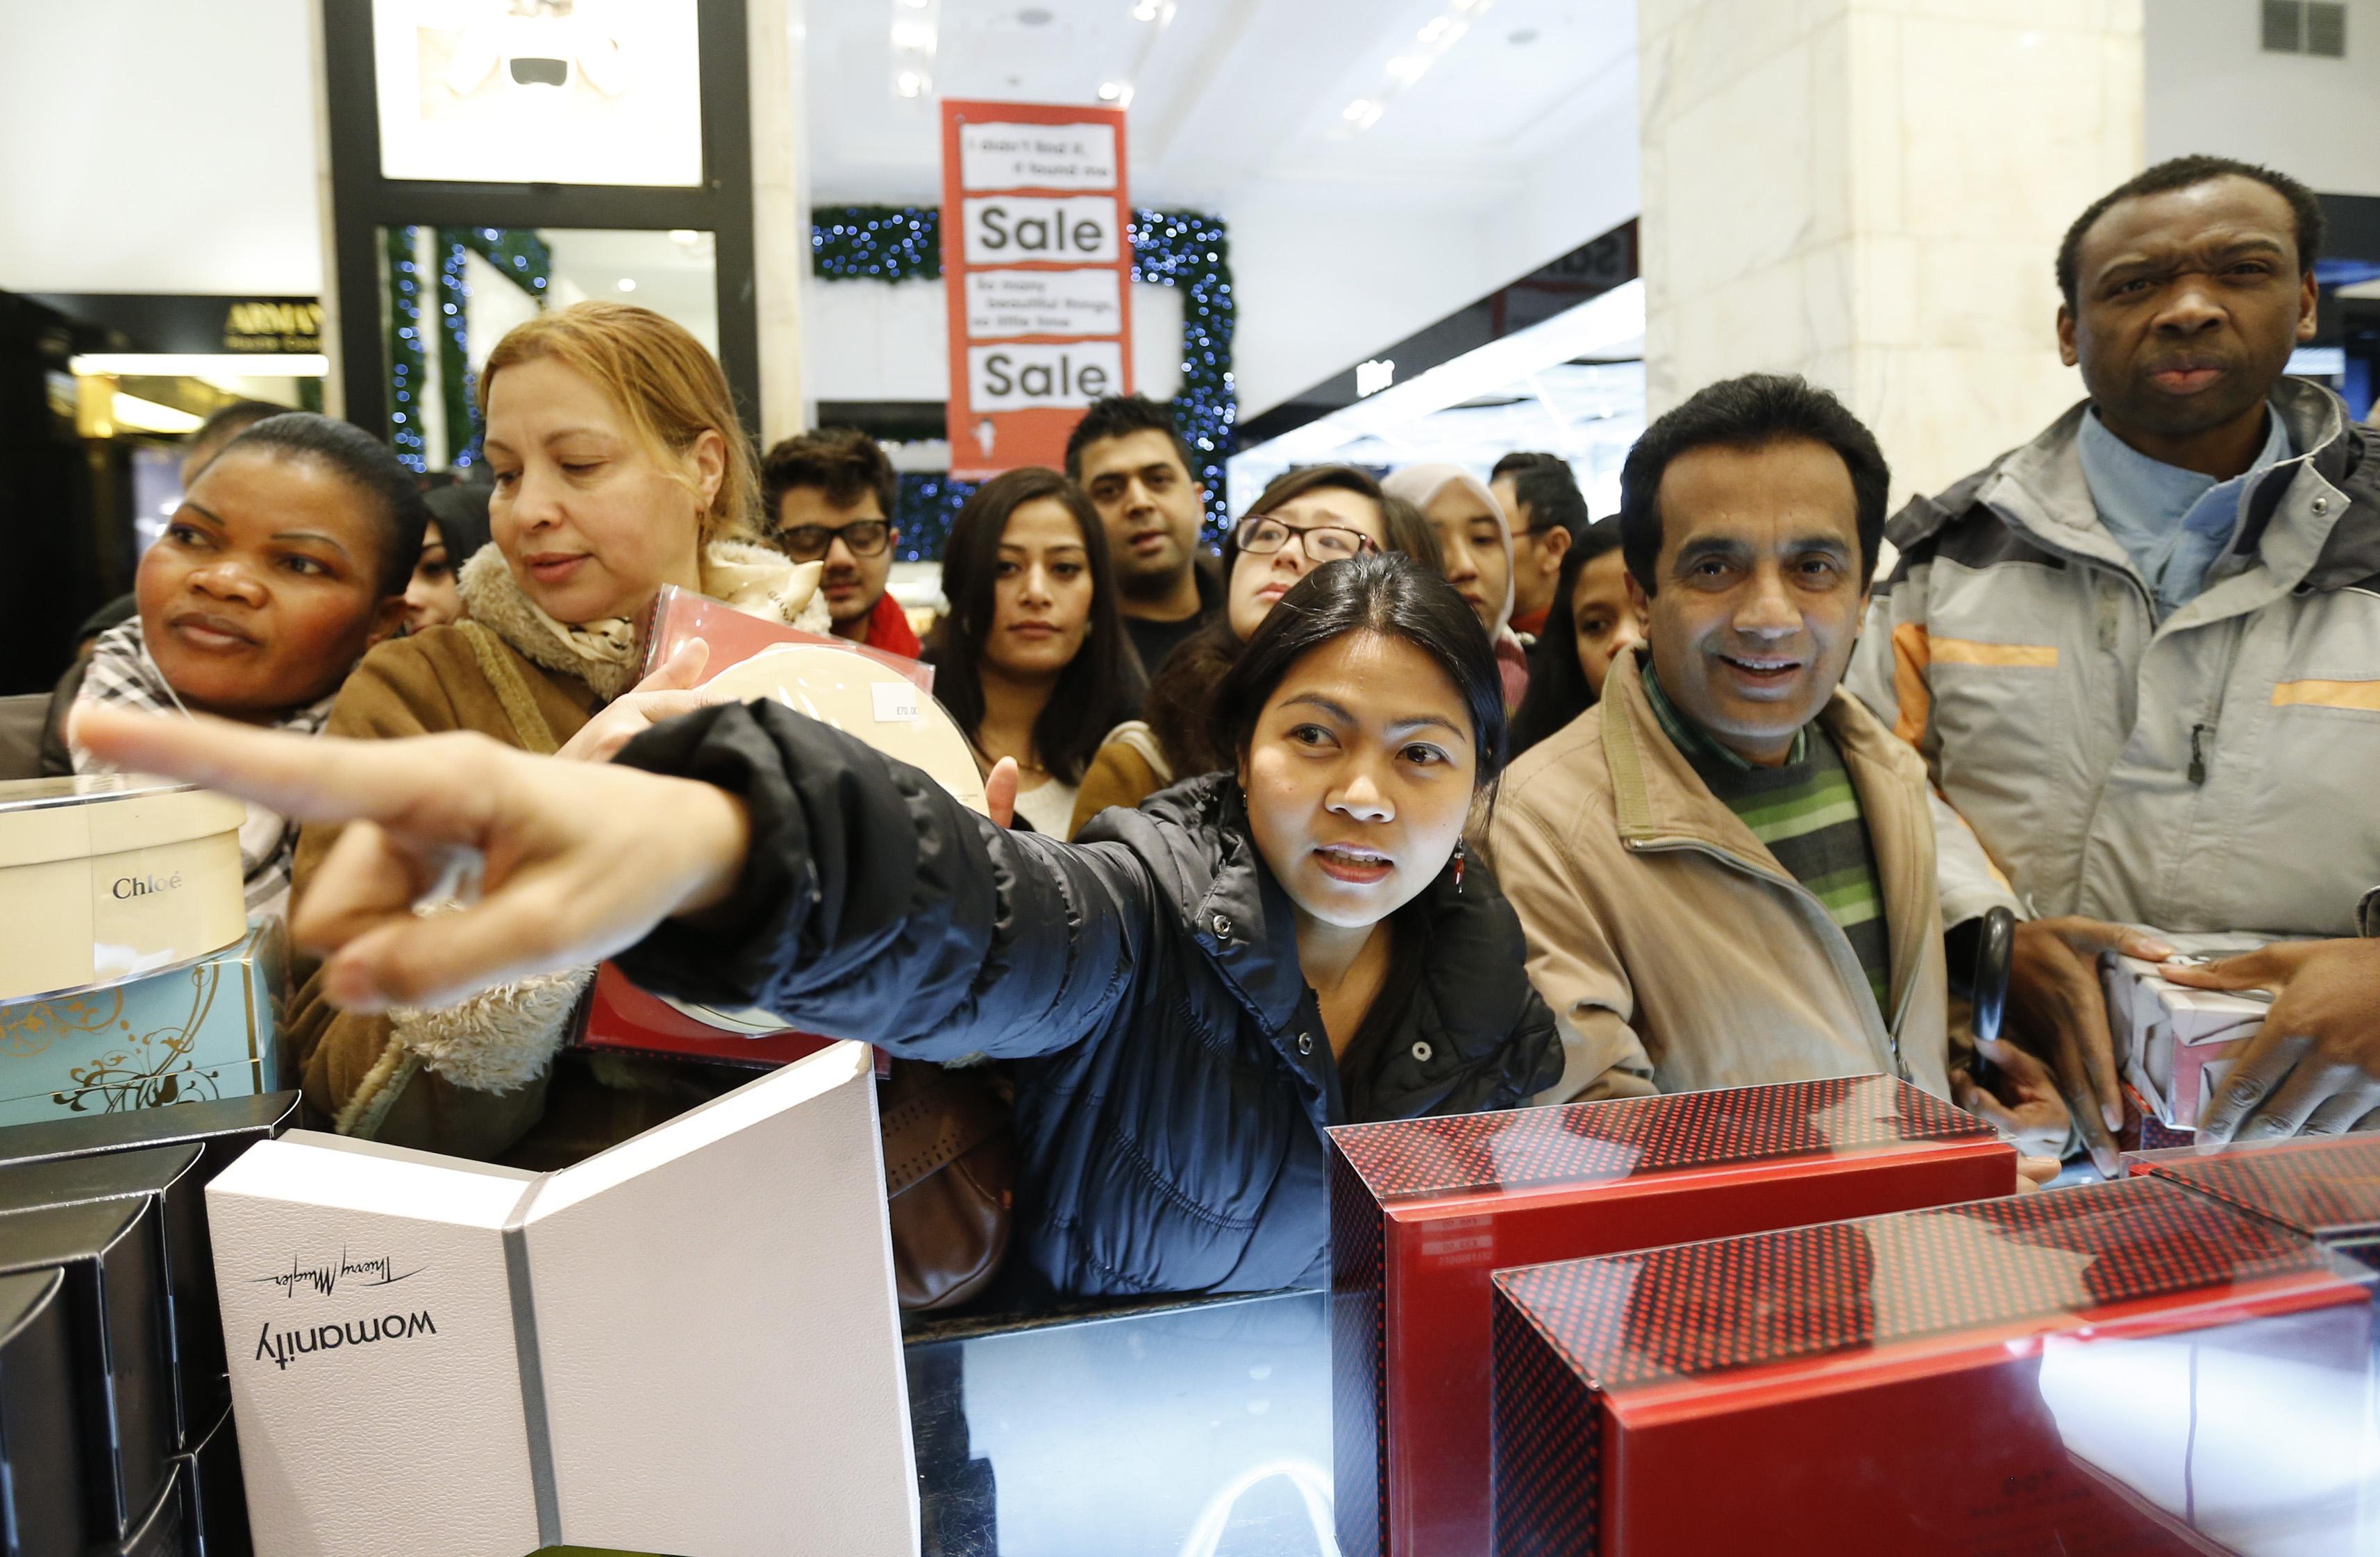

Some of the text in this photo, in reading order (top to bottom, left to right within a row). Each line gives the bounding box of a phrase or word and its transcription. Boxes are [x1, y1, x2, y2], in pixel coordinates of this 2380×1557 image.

[981, 206, 1103, 252] Sale
[985, 354, 1108, 397] Sale
[112, 870, 183, 900] Chloé
[244, 1243, 430, 1299] Thierry Mugler
[255, 1311, 437, 1370] womanity
